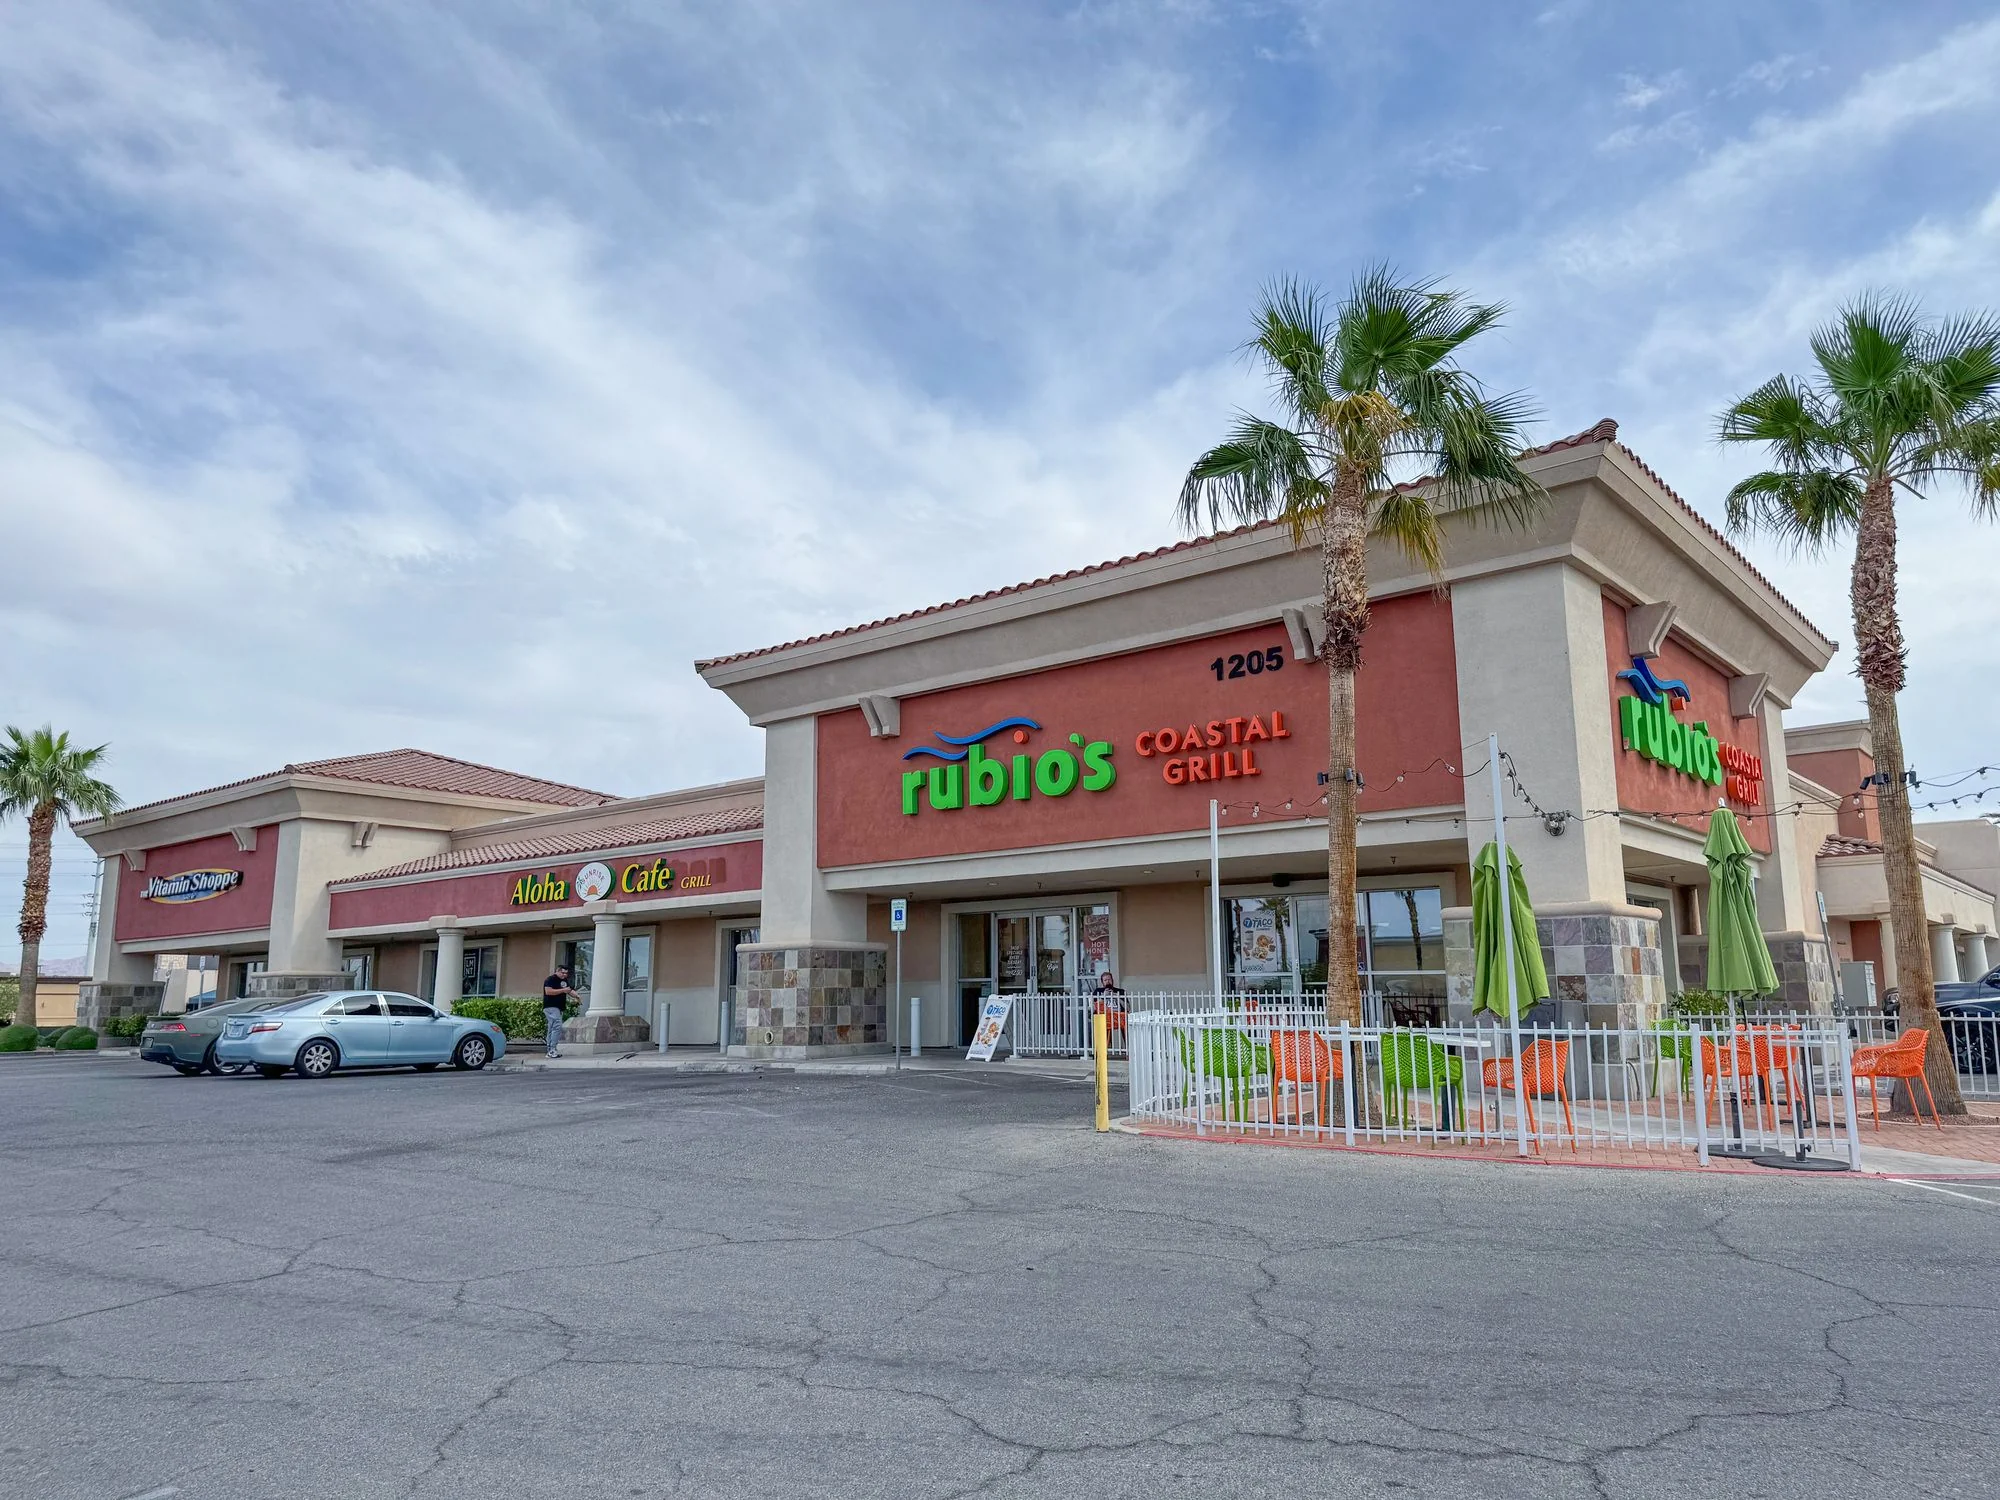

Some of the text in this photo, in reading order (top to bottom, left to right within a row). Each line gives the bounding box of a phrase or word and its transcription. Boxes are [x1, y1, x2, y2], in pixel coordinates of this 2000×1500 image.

[1210, 645, 1284, 682] 1205
[1135, 710, 1292, 758] COASTAL
[902, 729, 1118, 816] rubio's
[1162, 747, 1262, 785] GRILL
[1719, 741, 1765, 783] COASTAL
[1727, 774, 1761, 806] GRILL
[148, 876, 191, 898] Vitamin
[190, 871, 239, 891] Shoppe
[510, 873, 568, 906] Aloha
[681, 874, 711, 889] GRILL
[1252, 918, 1273, 928] TACO
